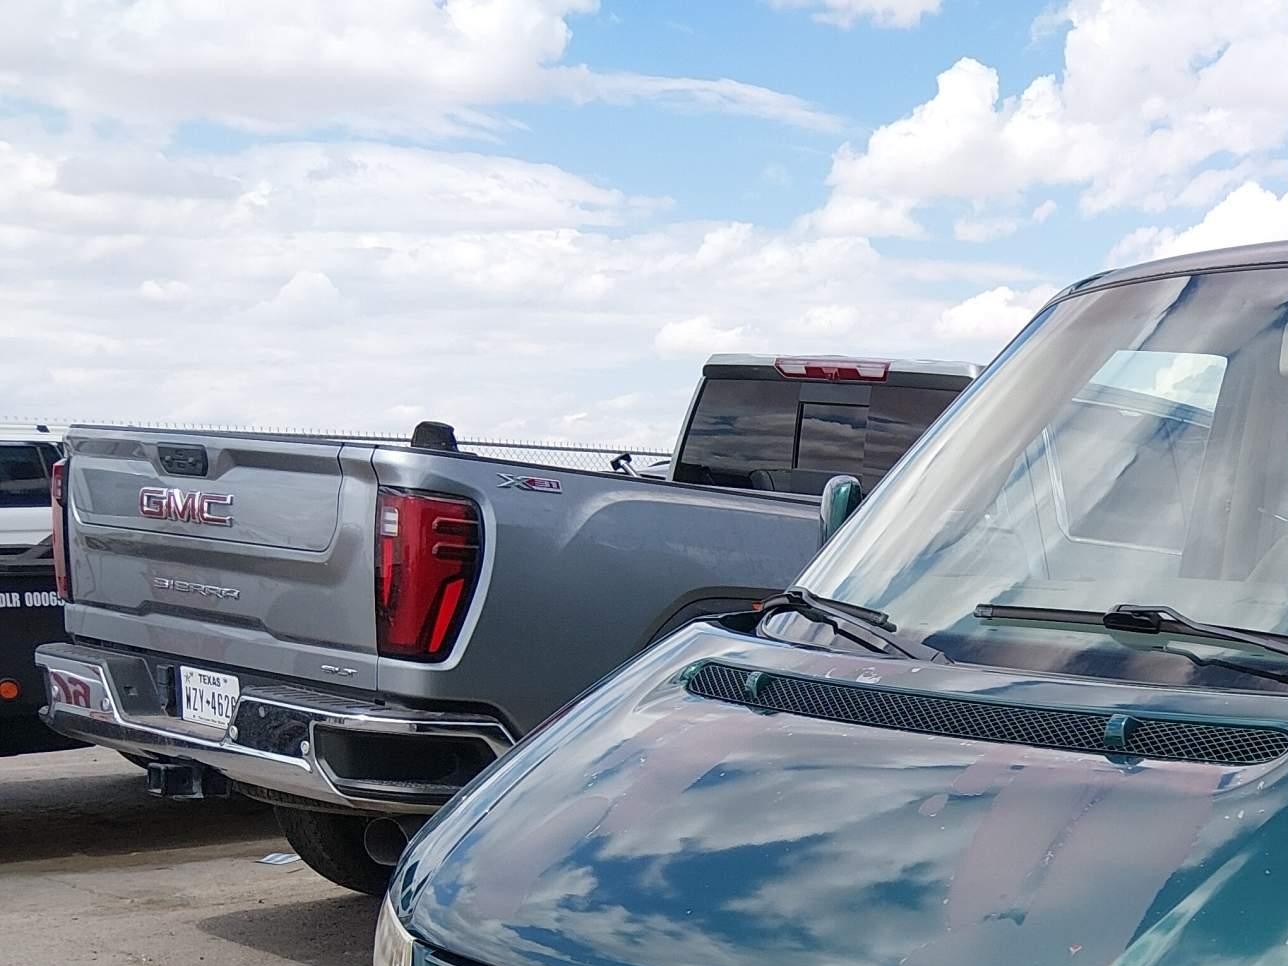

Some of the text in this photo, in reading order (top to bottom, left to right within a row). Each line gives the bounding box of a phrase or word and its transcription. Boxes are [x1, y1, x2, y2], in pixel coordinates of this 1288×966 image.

[139, 486, 235, 528] GMC
[153, 576, 241, 600] SIERRA
[0, 592, 21, 607] DLR
[199, 673, 221, 687] TEXAS
